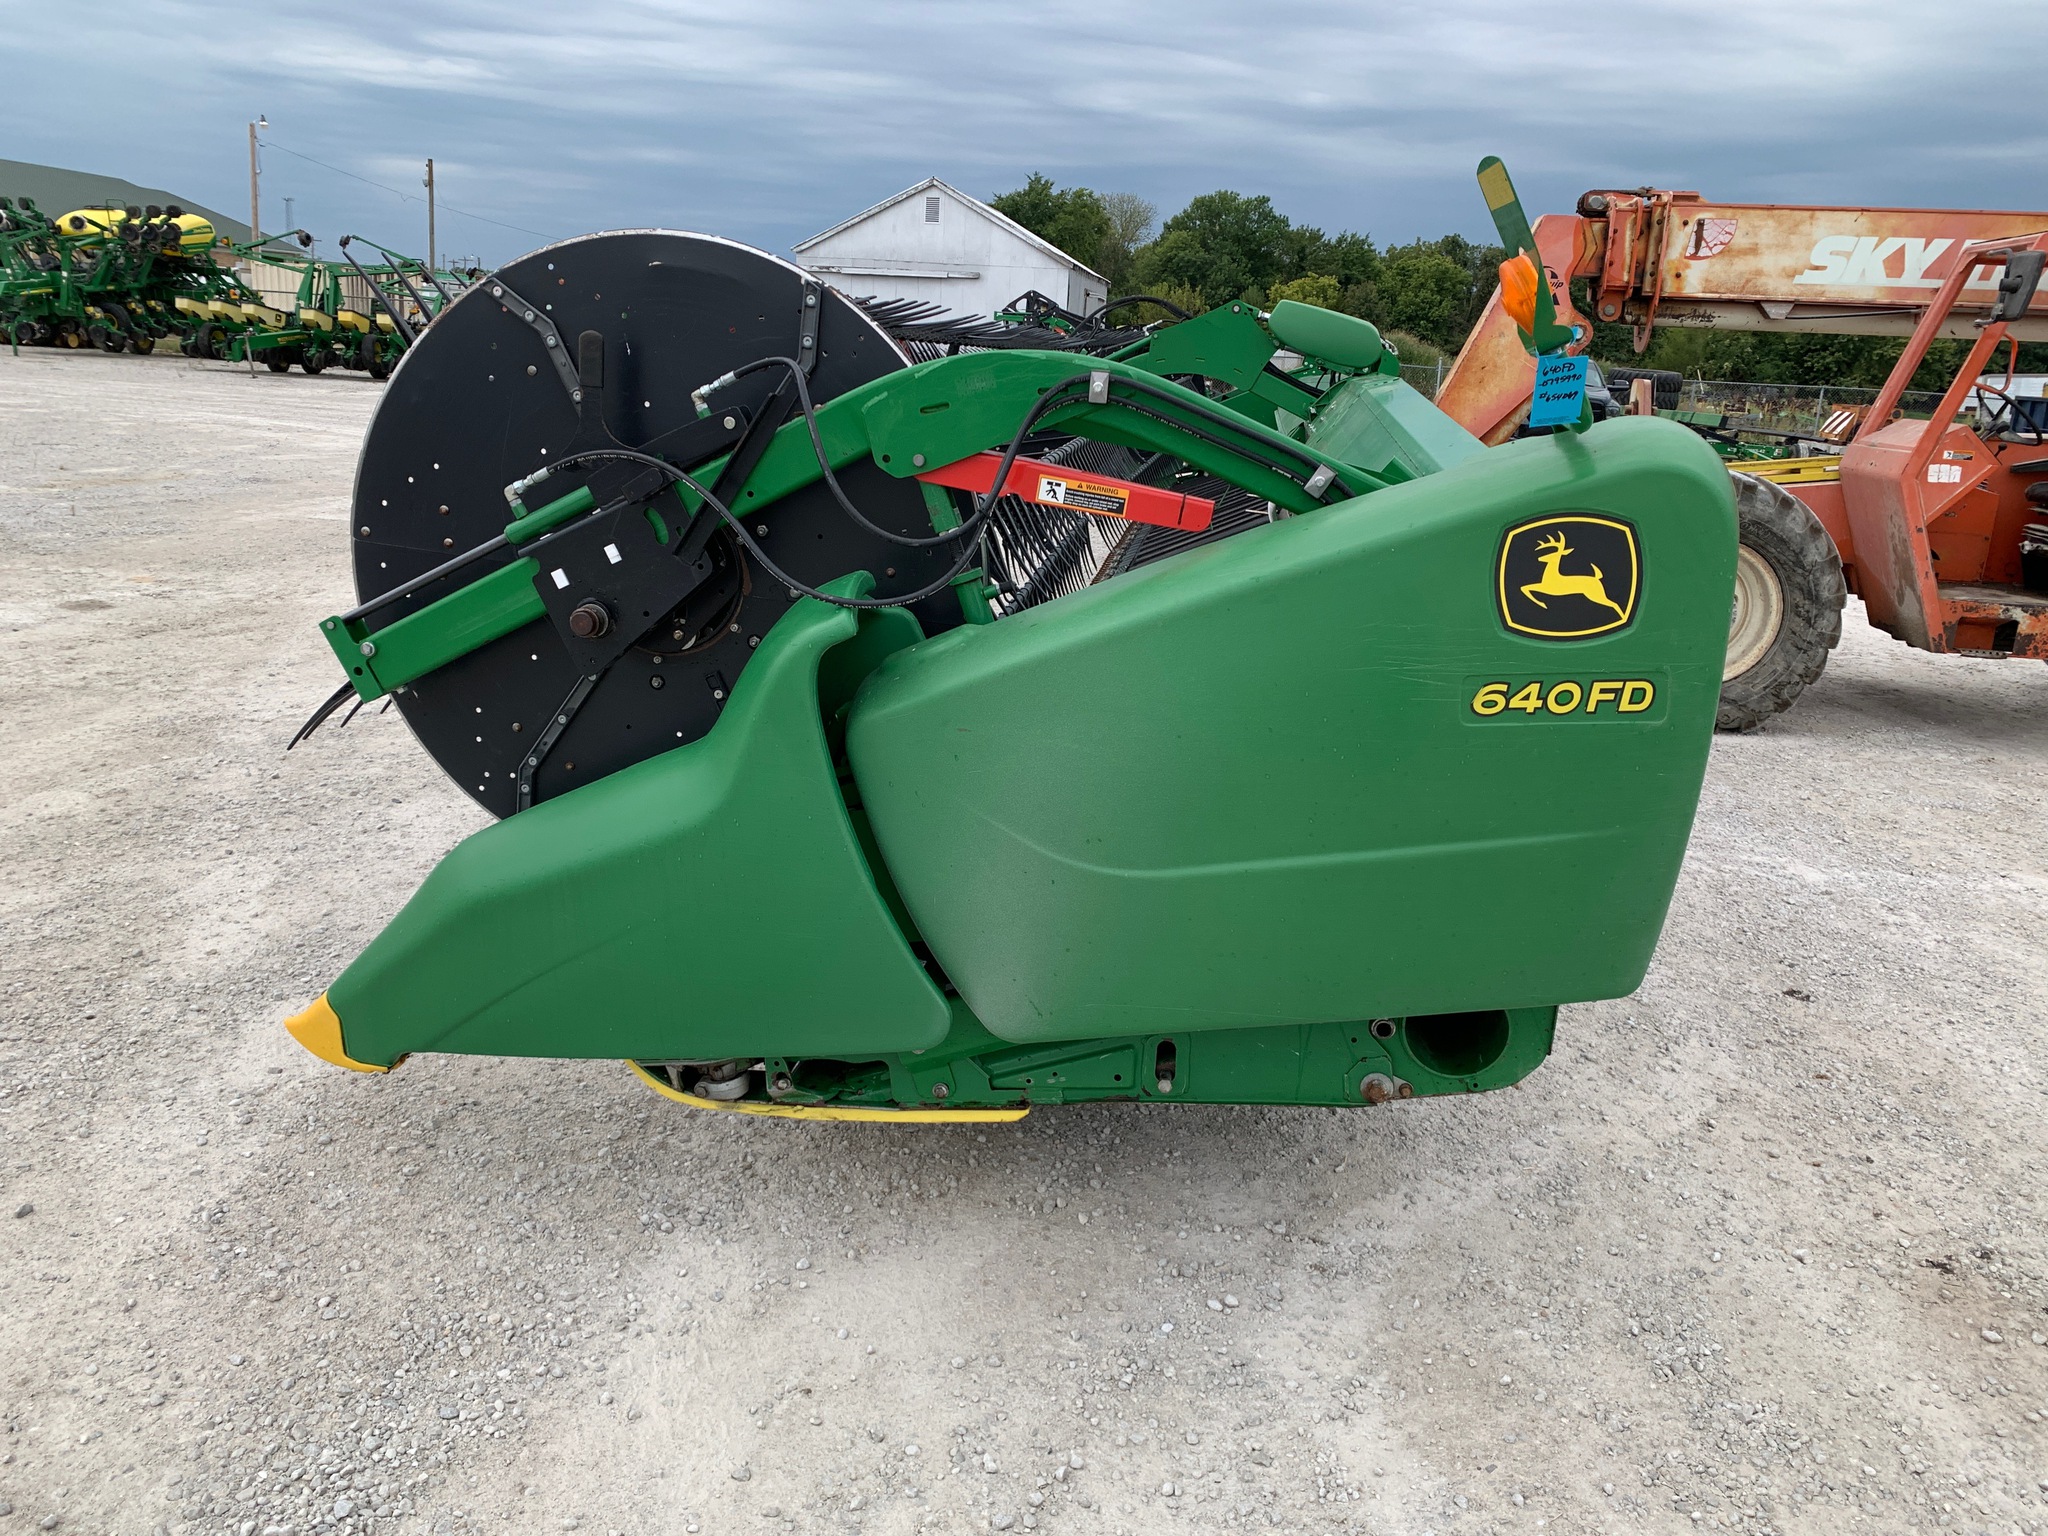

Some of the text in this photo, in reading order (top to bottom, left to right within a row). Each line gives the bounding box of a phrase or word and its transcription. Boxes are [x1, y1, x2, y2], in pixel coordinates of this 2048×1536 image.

[1542, 362, 1576, 376] 640FD
[1085, 483, 1119, 496] WARNING
[1470, 678, 1656, 716] 640FD
